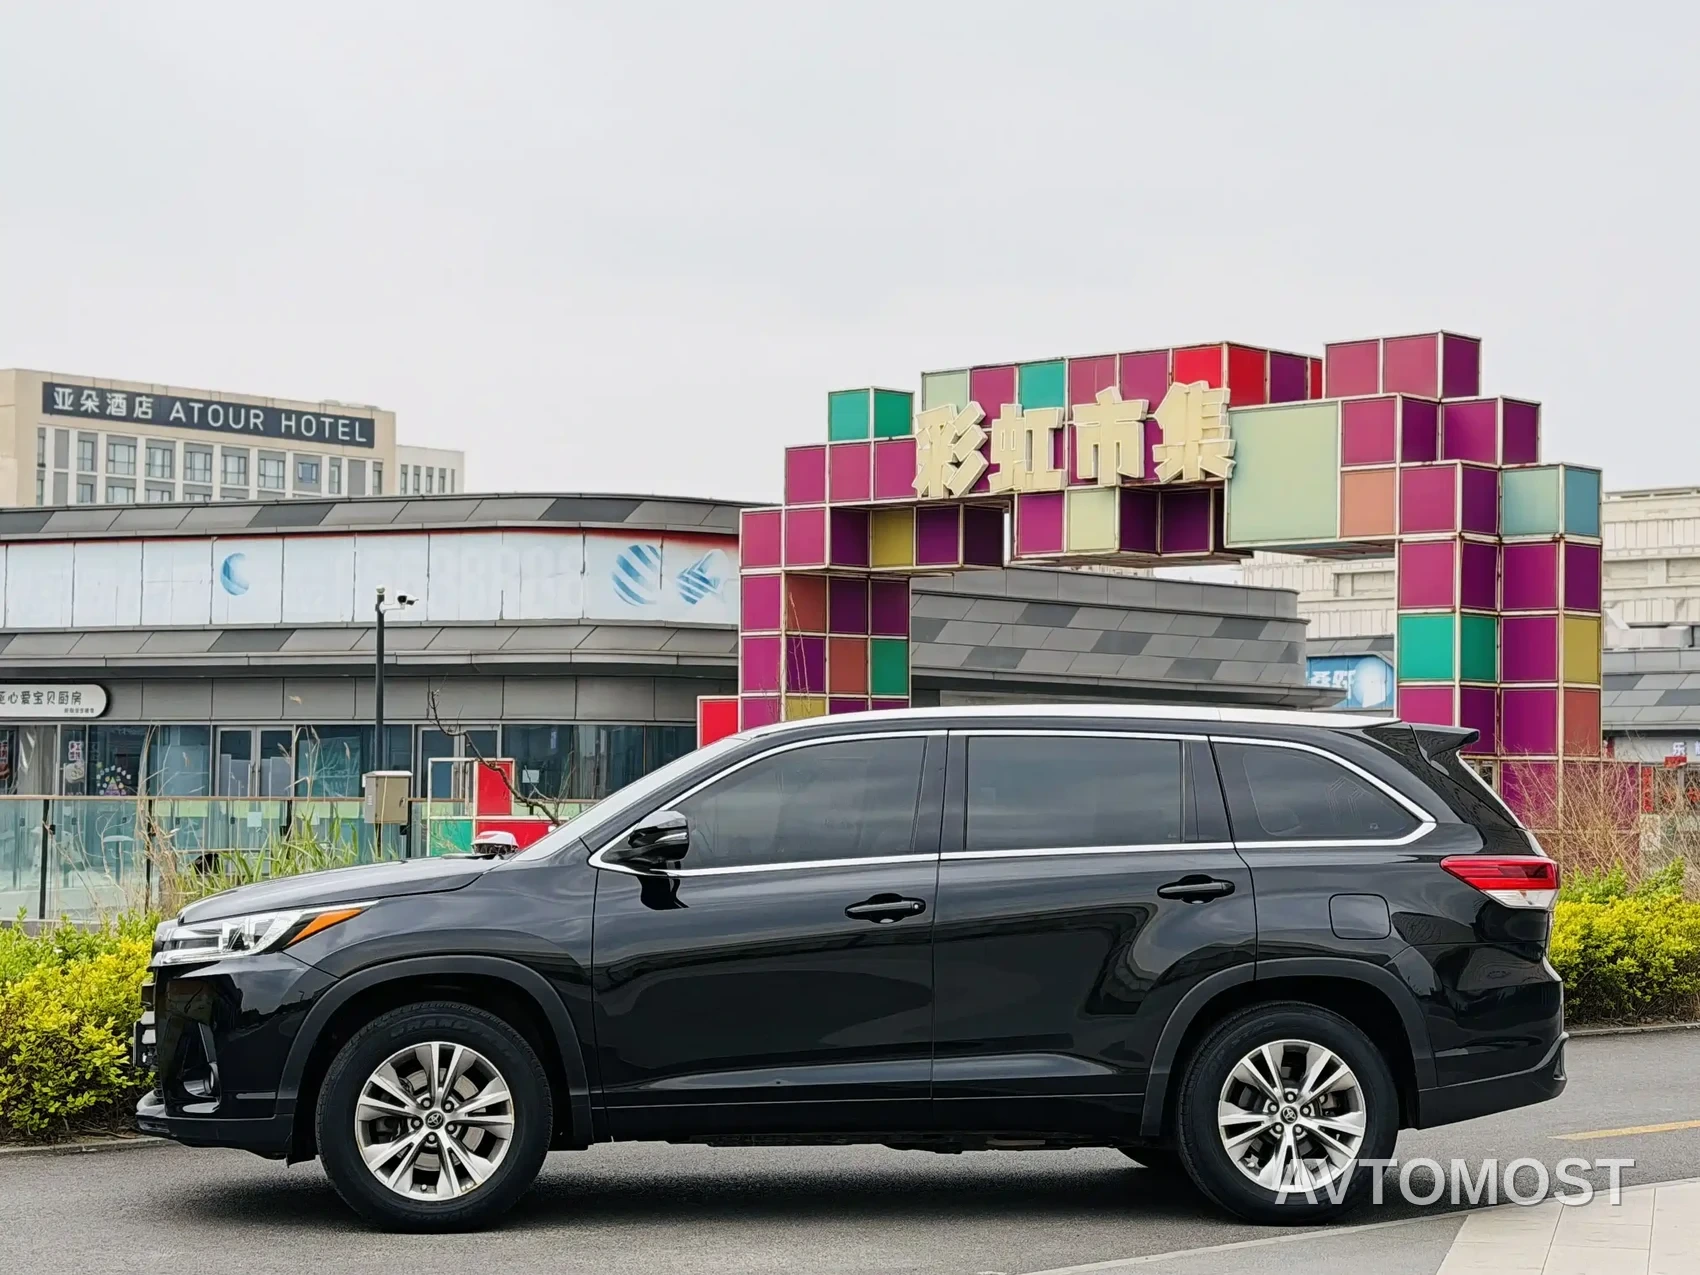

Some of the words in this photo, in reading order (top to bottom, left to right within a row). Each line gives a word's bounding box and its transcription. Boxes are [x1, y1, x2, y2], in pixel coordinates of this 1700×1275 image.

[53, 387, 154, 419] 亚朵酒店
[169, 400, 264, 431] ATOUR
[281, 413, 367, 442] HOTEL
[912, 380, 1236, 499] 彩虹市集
